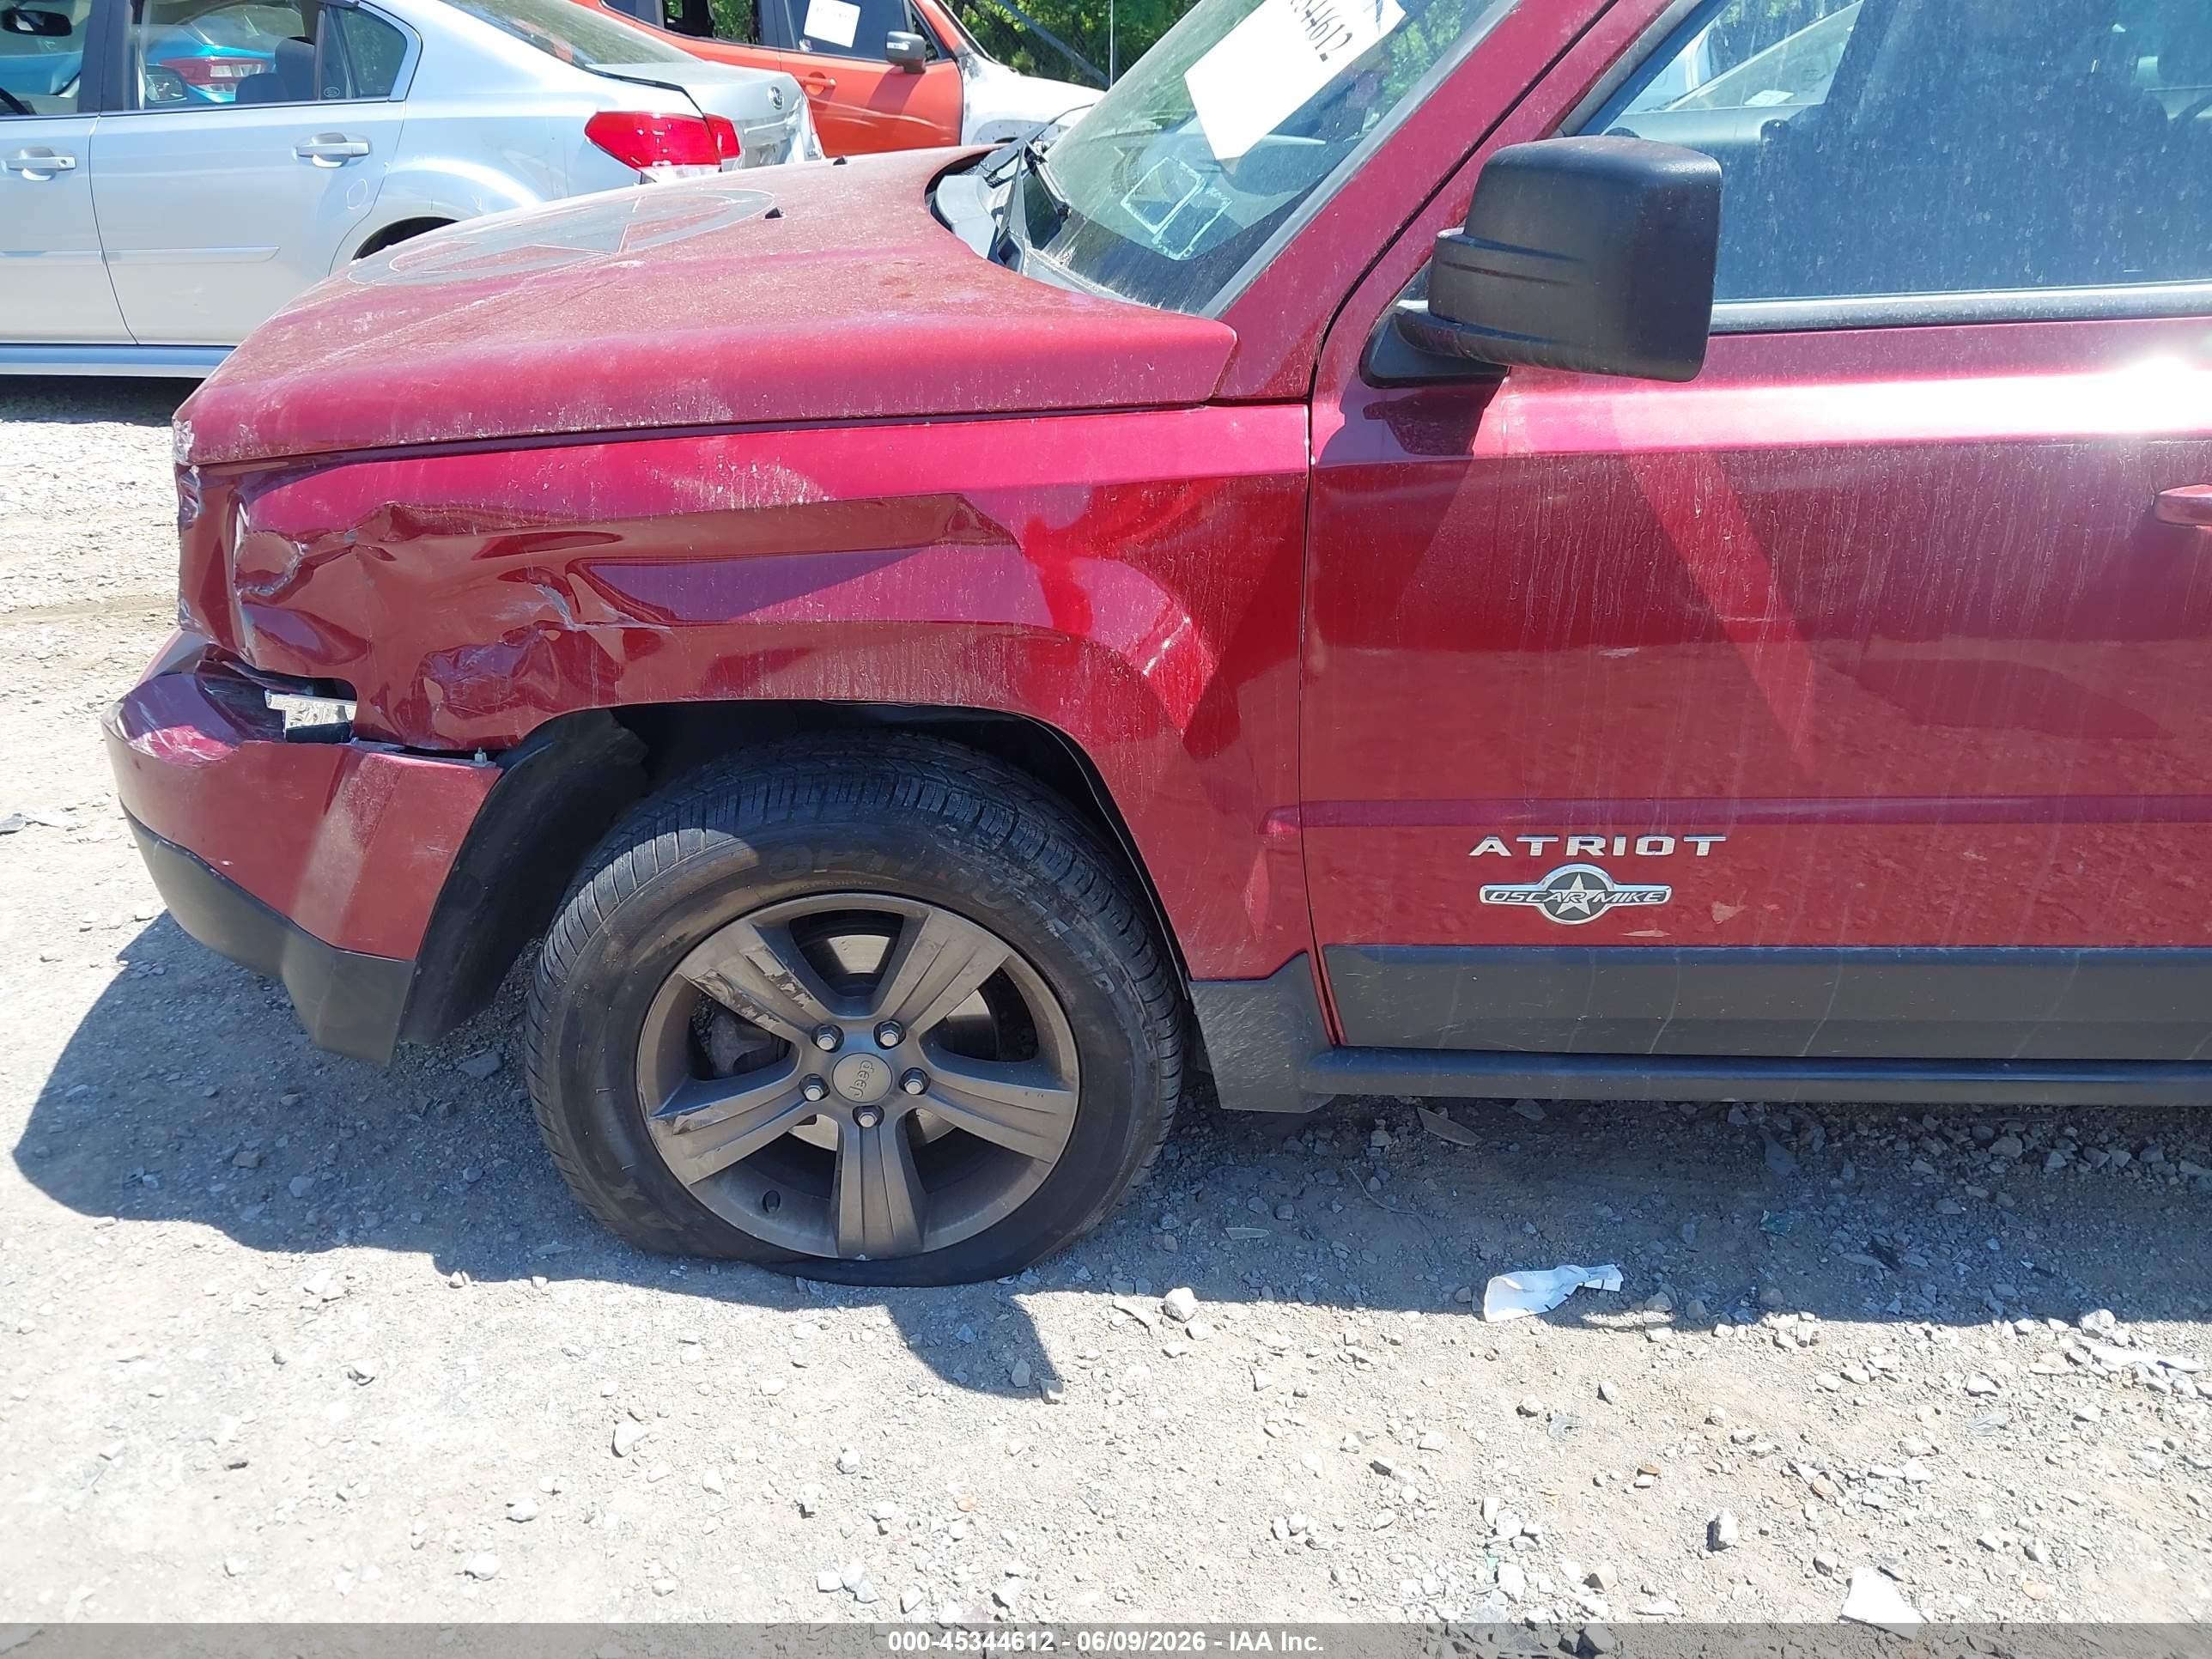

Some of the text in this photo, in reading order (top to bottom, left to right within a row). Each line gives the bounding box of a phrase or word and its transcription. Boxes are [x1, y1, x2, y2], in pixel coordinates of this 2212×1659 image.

[1468, 835, 1727, 857] ATRIOT
[1488, 890, 1664, 904] OSCAR MIKE
[848, 1060, 875, 1099] Jeep
